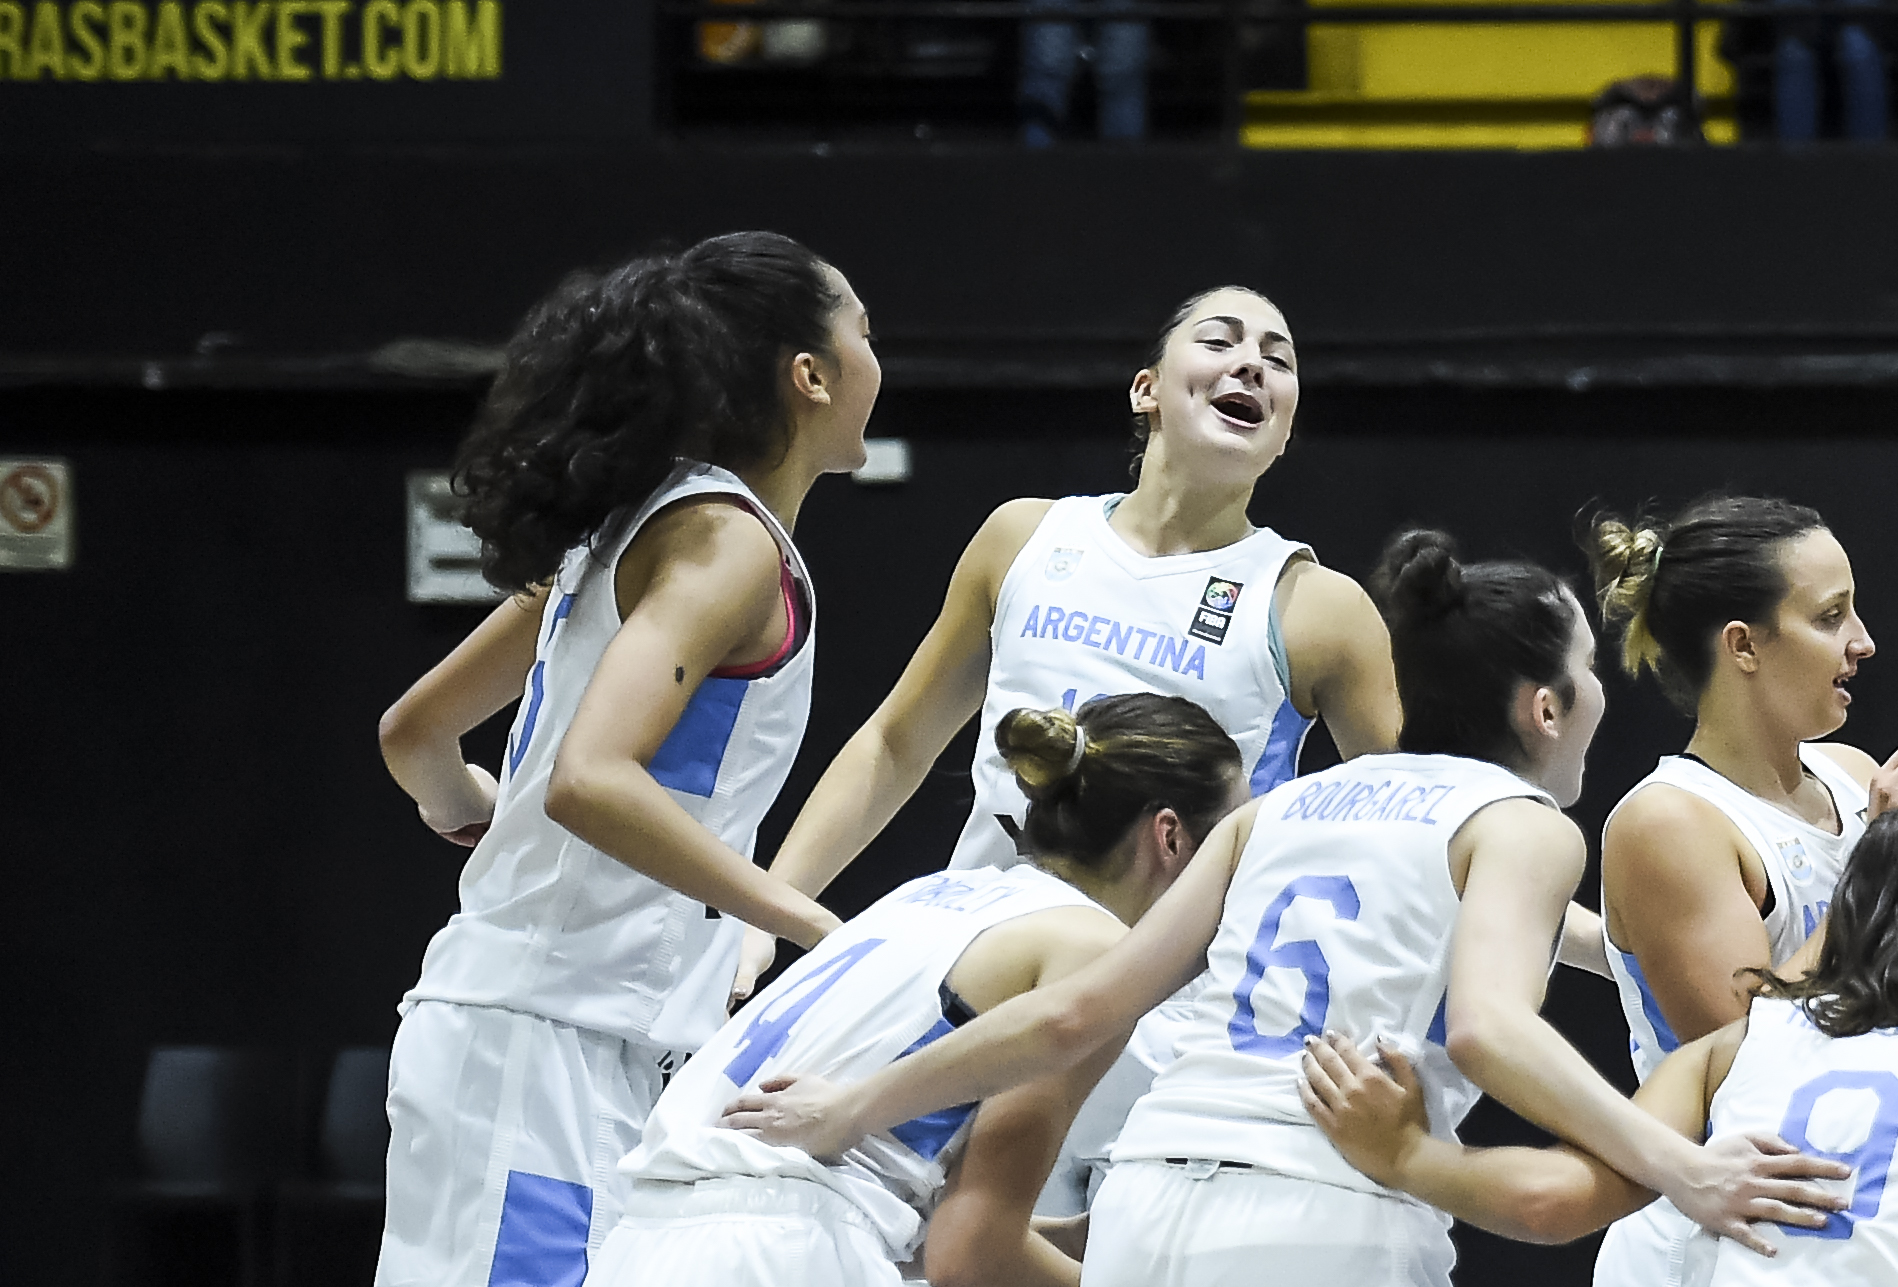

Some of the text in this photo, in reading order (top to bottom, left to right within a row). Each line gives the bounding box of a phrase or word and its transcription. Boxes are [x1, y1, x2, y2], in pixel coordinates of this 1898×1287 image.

[1020, 603, 1206, 681] ARGENTINA
[722, 937, 888, 1089] 4
[1227, 874, 1361, 1060] 6
